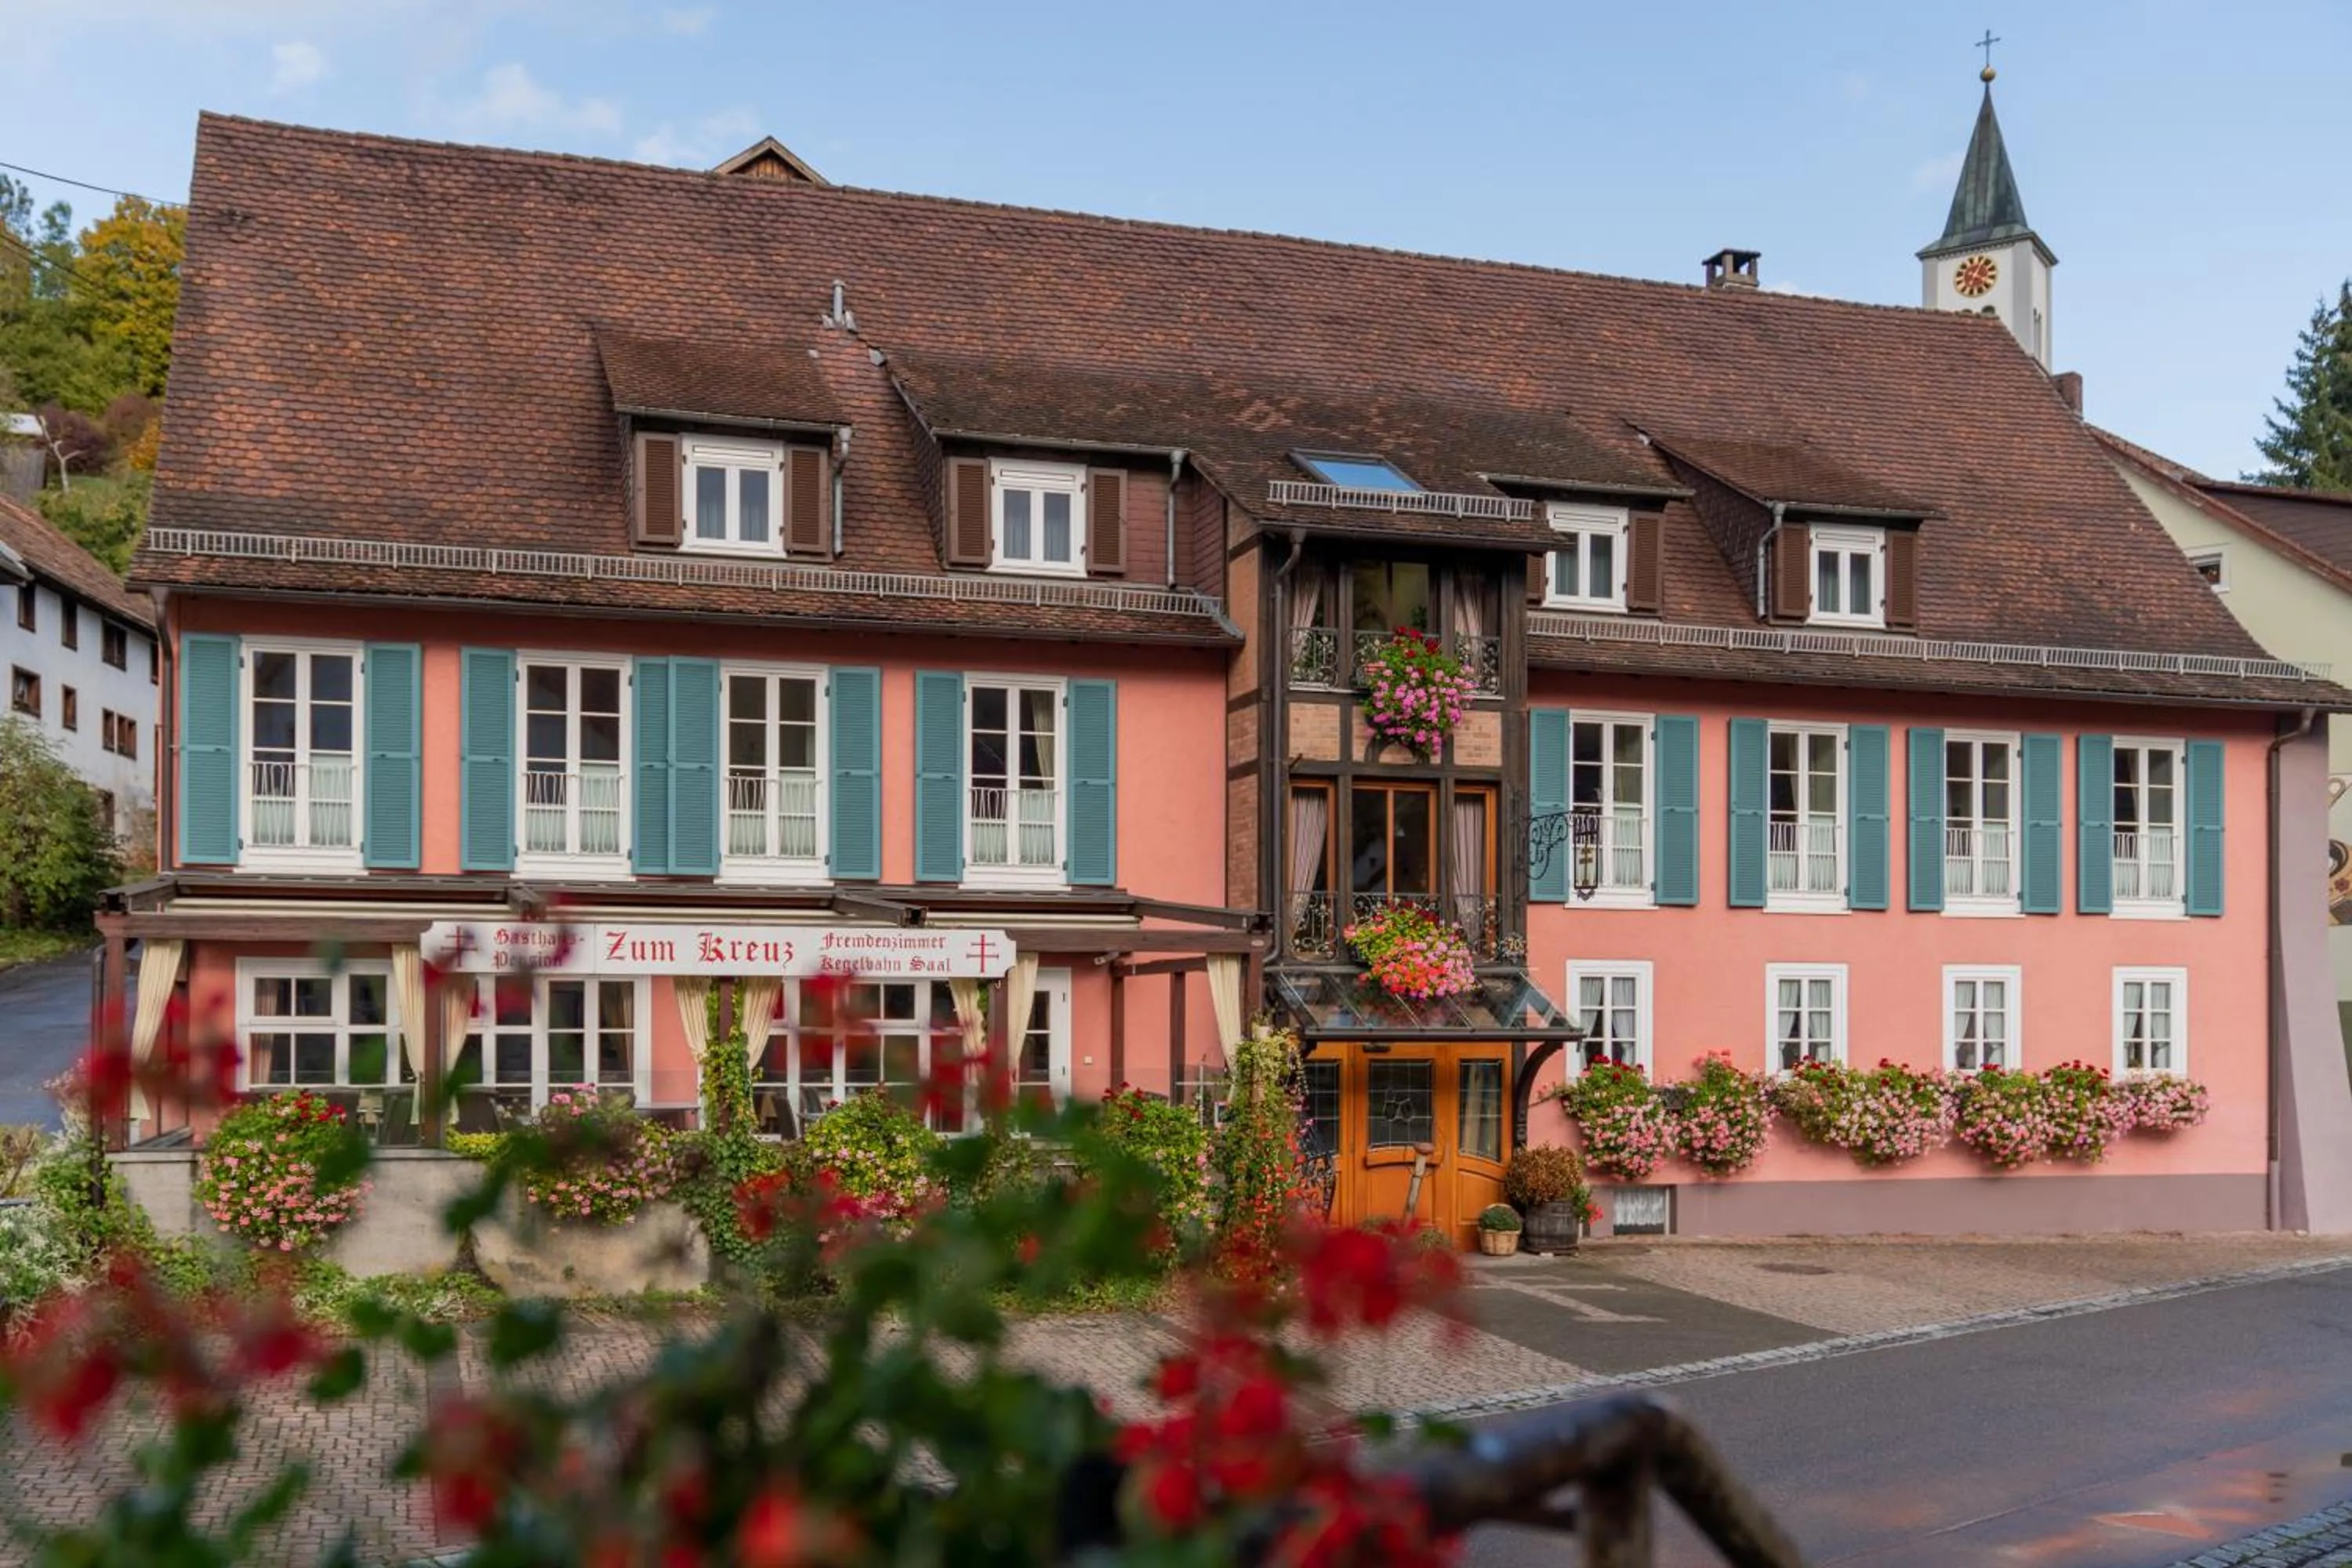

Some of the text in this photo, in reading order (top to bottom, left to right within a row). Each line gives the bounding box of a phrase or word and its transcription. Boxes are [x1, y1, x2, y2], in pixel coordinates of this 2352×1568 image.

[606, 931, 794, 968] Zum Kreuz
[821, 932, 946, 951] Fremdenzimmer
[820, 954, 951, 975] Kegelbahn Saal
